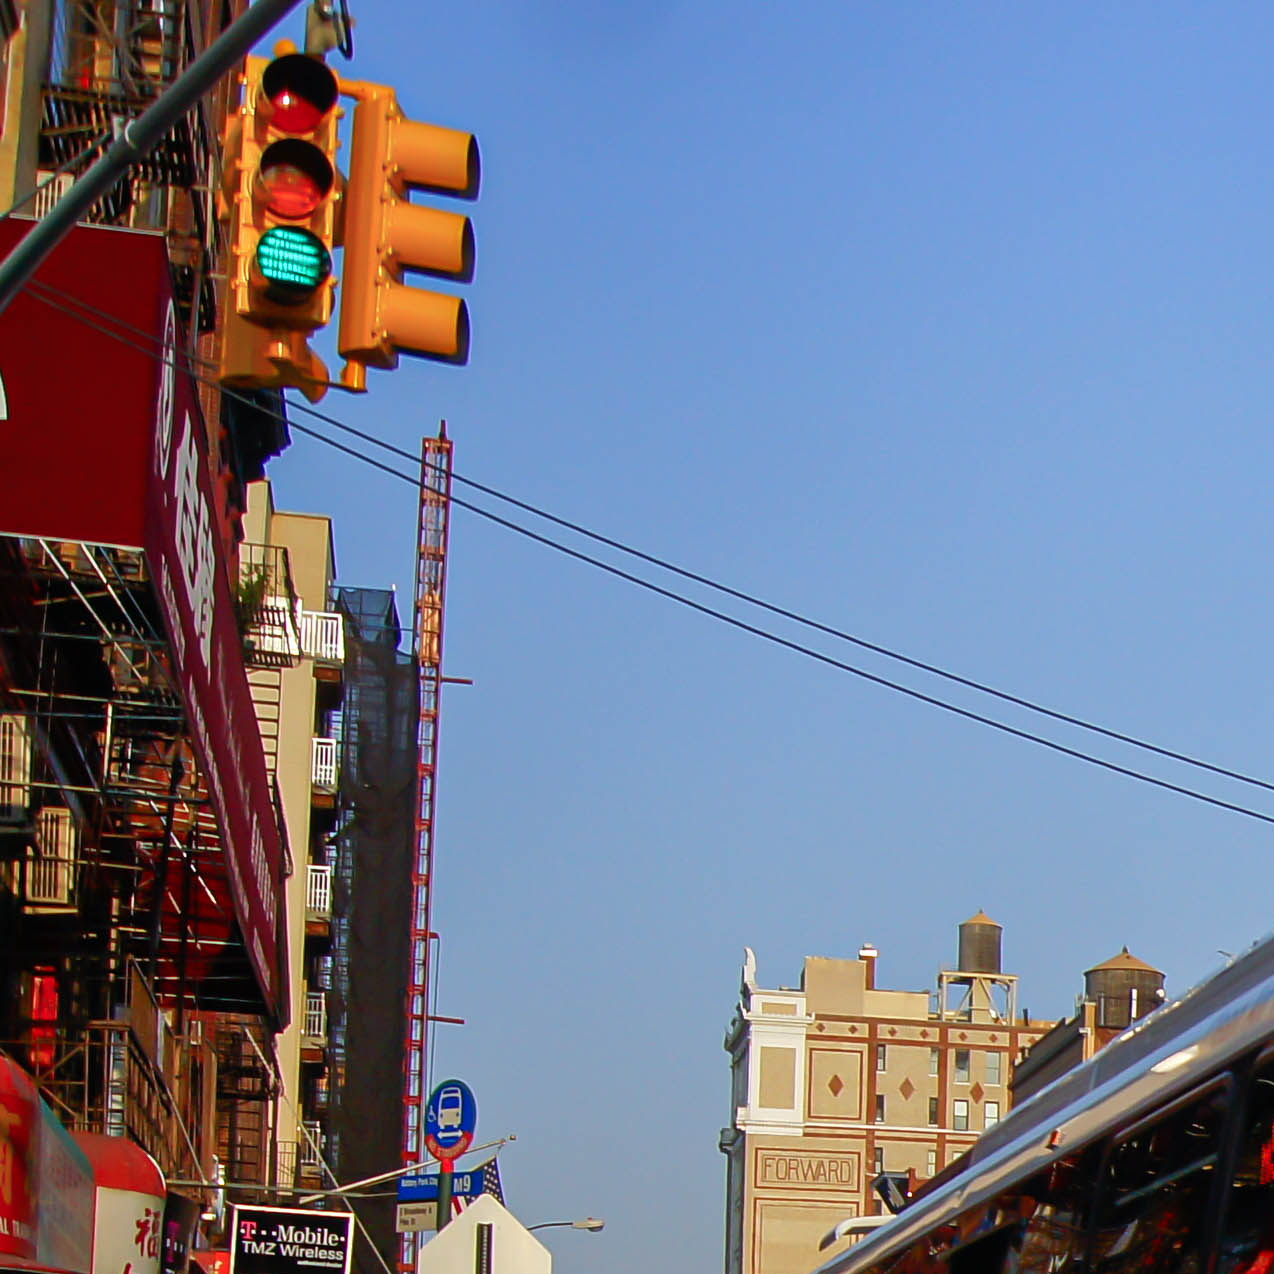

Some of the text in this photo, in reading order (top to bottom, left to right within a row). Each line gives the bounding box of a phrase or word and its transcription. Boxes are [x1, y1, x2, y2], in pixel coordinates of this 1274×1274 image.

[764, 1157, 851, 1183] FORWARD
[453, 1174, 471, 1193] M9
[242, 1240, 344, 1261] TMZ Wireless
